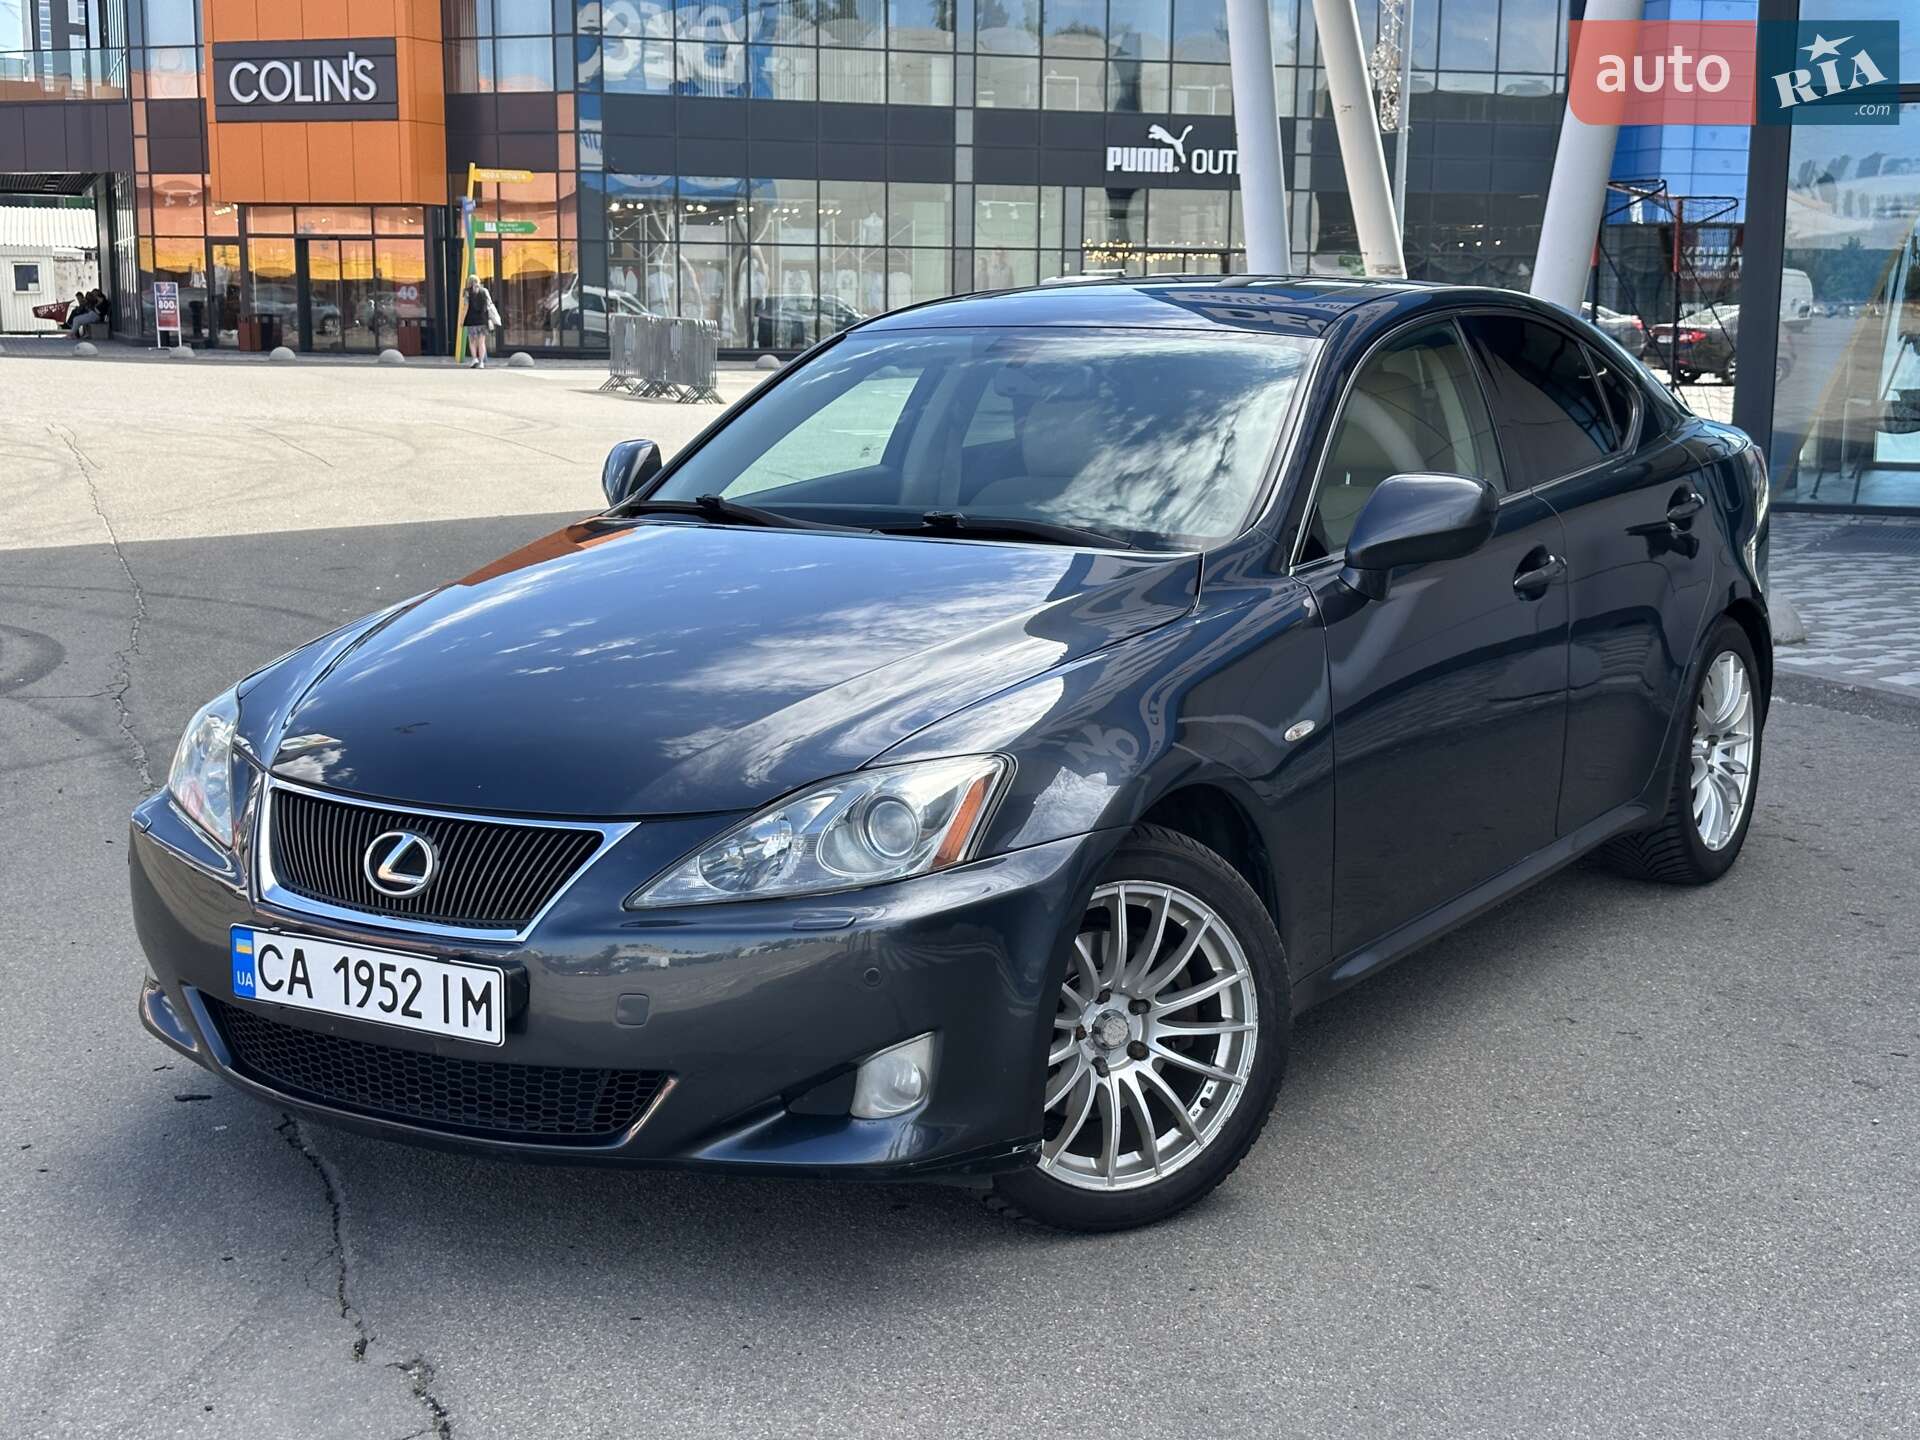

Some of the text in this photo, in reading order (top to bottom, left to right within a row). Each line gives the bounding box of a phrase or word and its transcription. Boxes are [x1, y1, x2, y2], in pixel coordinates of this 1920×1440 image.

[228, 51, 378, 103] COLIN'S
[1191, 148, 1240, 175] OUT
[236, 970, 254, 989] UA
[257, 943, 493, 1032] CA 1952 IM
